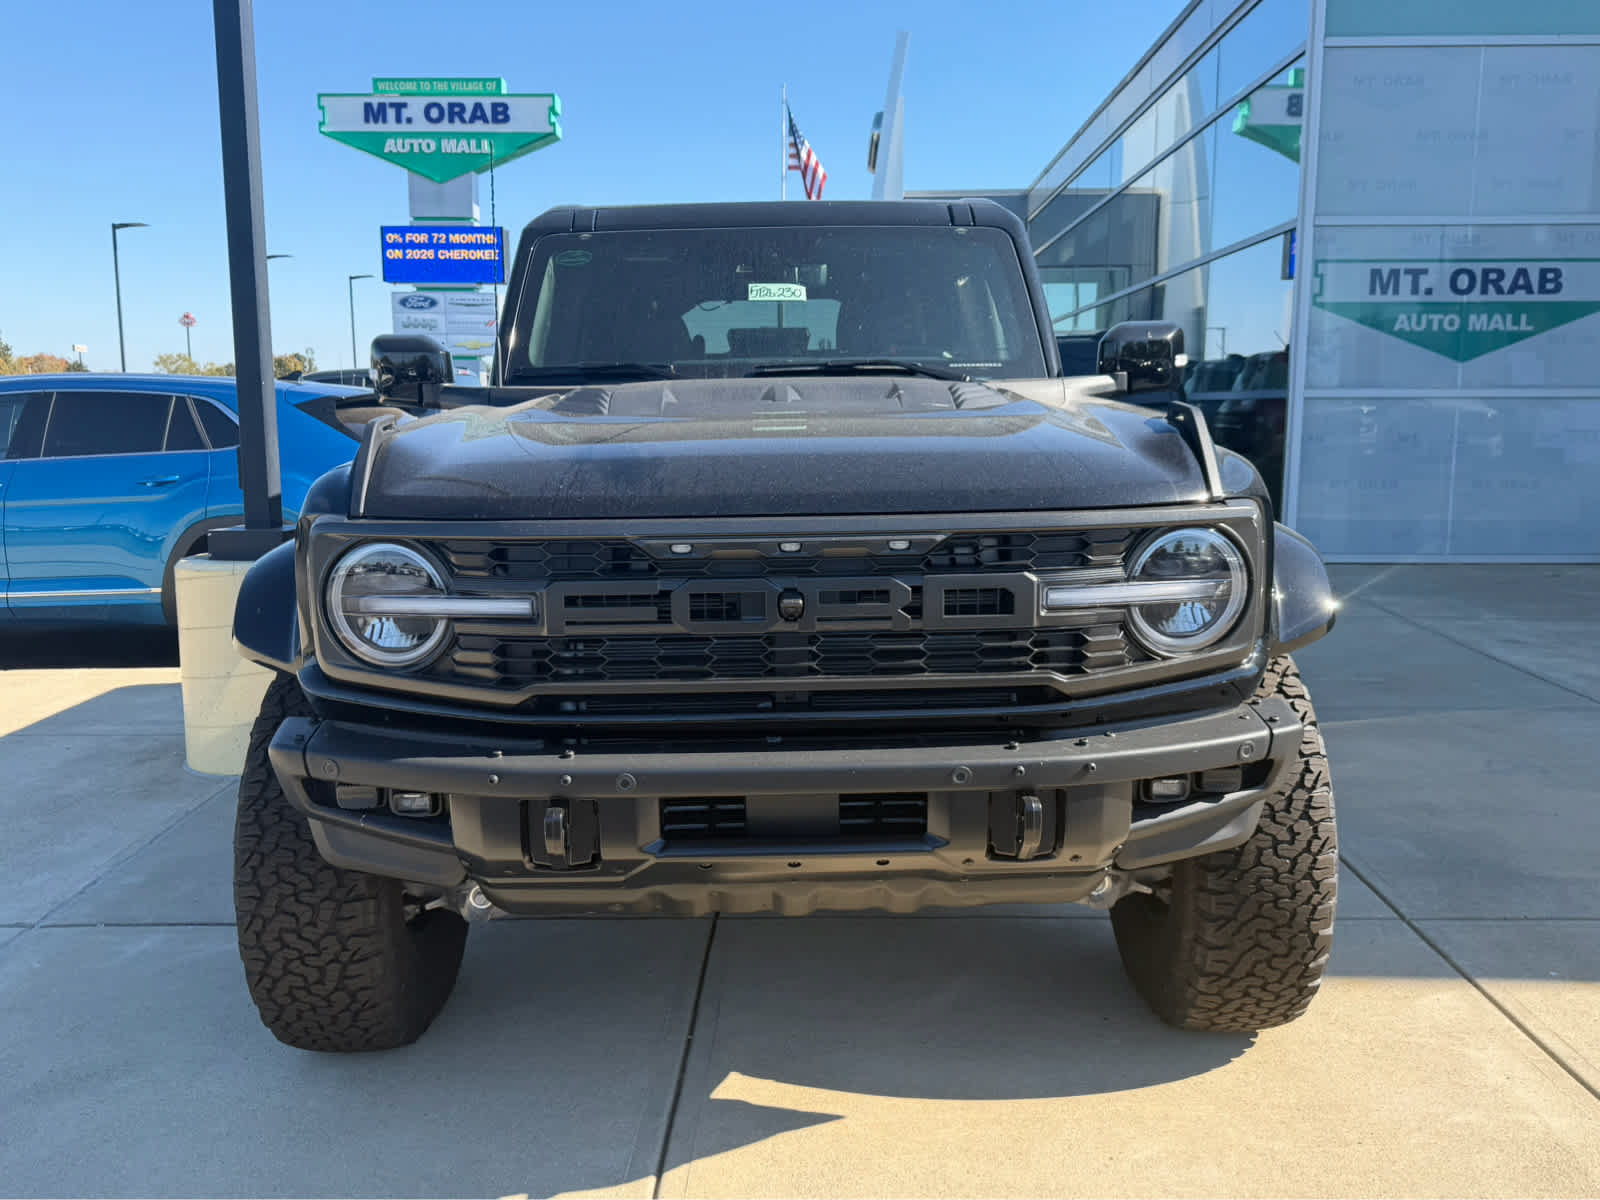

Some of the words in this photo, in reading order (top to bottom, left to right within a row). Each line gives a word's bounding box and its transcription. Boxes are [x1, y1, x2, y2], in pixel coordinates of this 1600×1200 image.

[377, 81, 418, 91] WELCOME
[420, 81, 431, 91] TO
[432, 81, 448, 91] THE
[450, 81, 484, 91] VILLAGE
[486, 81, 497, 91] OF
[363, 102, 413, 124] MT.
[423, 101, 511, 124] ORAB
[384, 138, 436, 153] AUTO
[441, 138, 492, 153] MALL
[386, 233, 403, 244] 0%
[405, 233, 429, 244] FOR
[431, 233, 447, 244] 72
[386, 249, 404, 260] ON
[406, 249, 434, 260] 2026
[438, 249, 499, 260] CHEROKEE
[1368, 268, 1433, 296] MT.
[1449, 267, 1563, 296] ORAB
[405, 294, 431, 309] Ford
[1393, 313, 1461, 332] AUTO
[1467, 313, 1535, 332] MALL
[545, 573, 1038, 634] FORD
